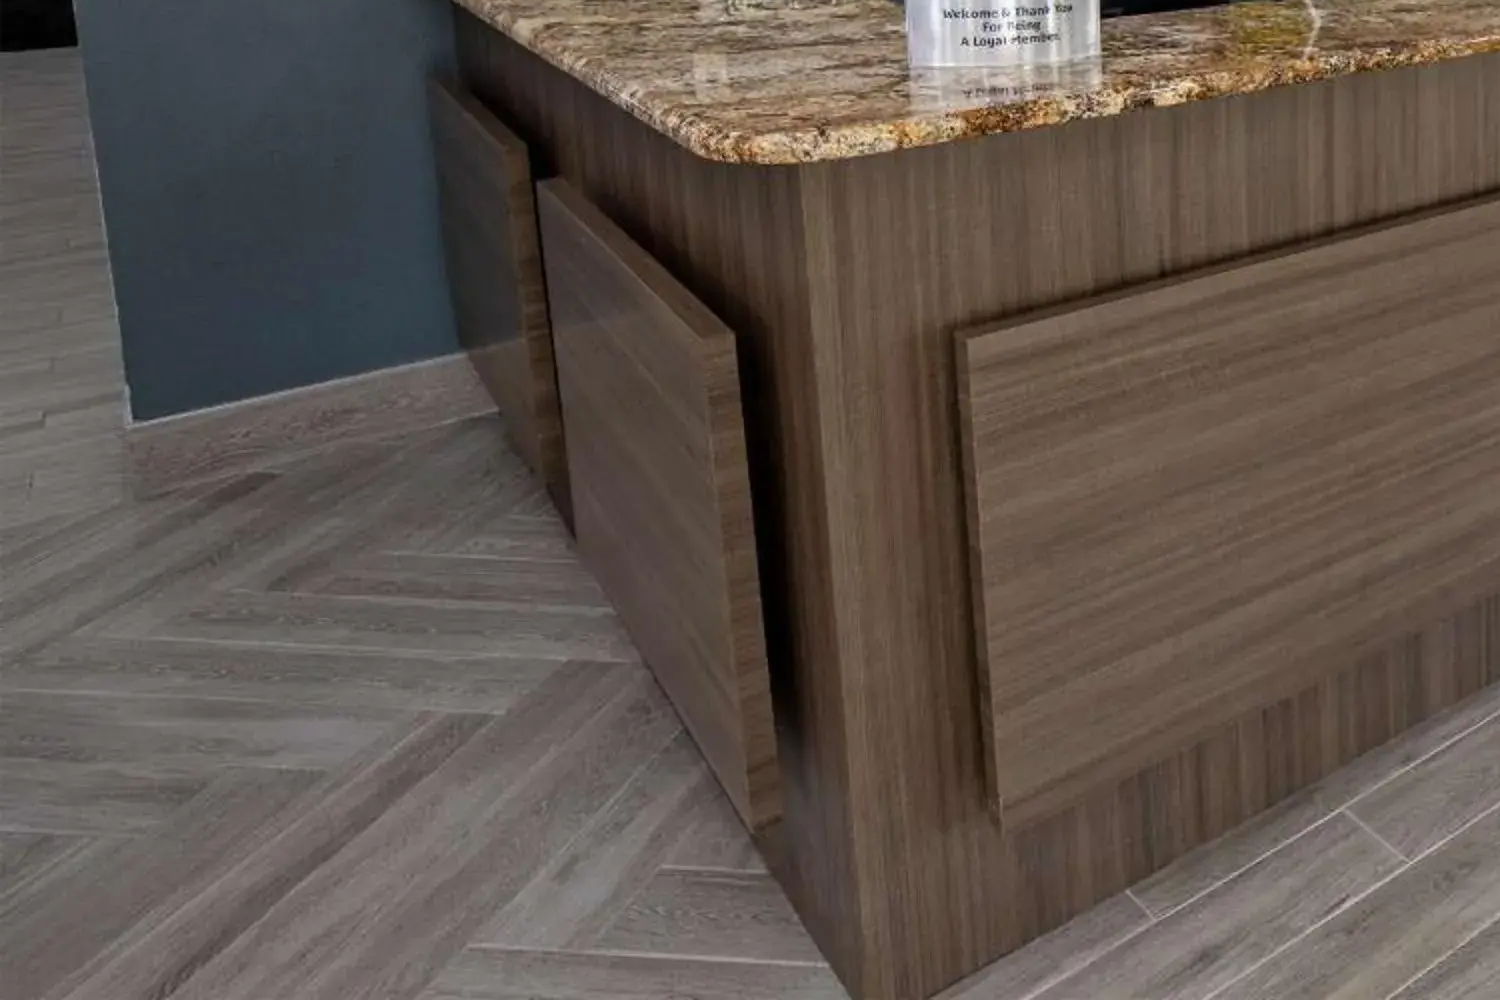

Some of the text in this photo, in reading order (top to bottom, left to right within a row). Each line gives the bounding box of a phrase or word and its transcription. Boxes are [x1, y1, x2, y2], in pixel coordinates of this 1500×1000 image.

[943, 3, 1073, 19] Welcome & Thank You
[982, 20, 1041, 33] For Being
[960, 35, 969, 46] A
[973, 34, 1007, 48] Loyal
